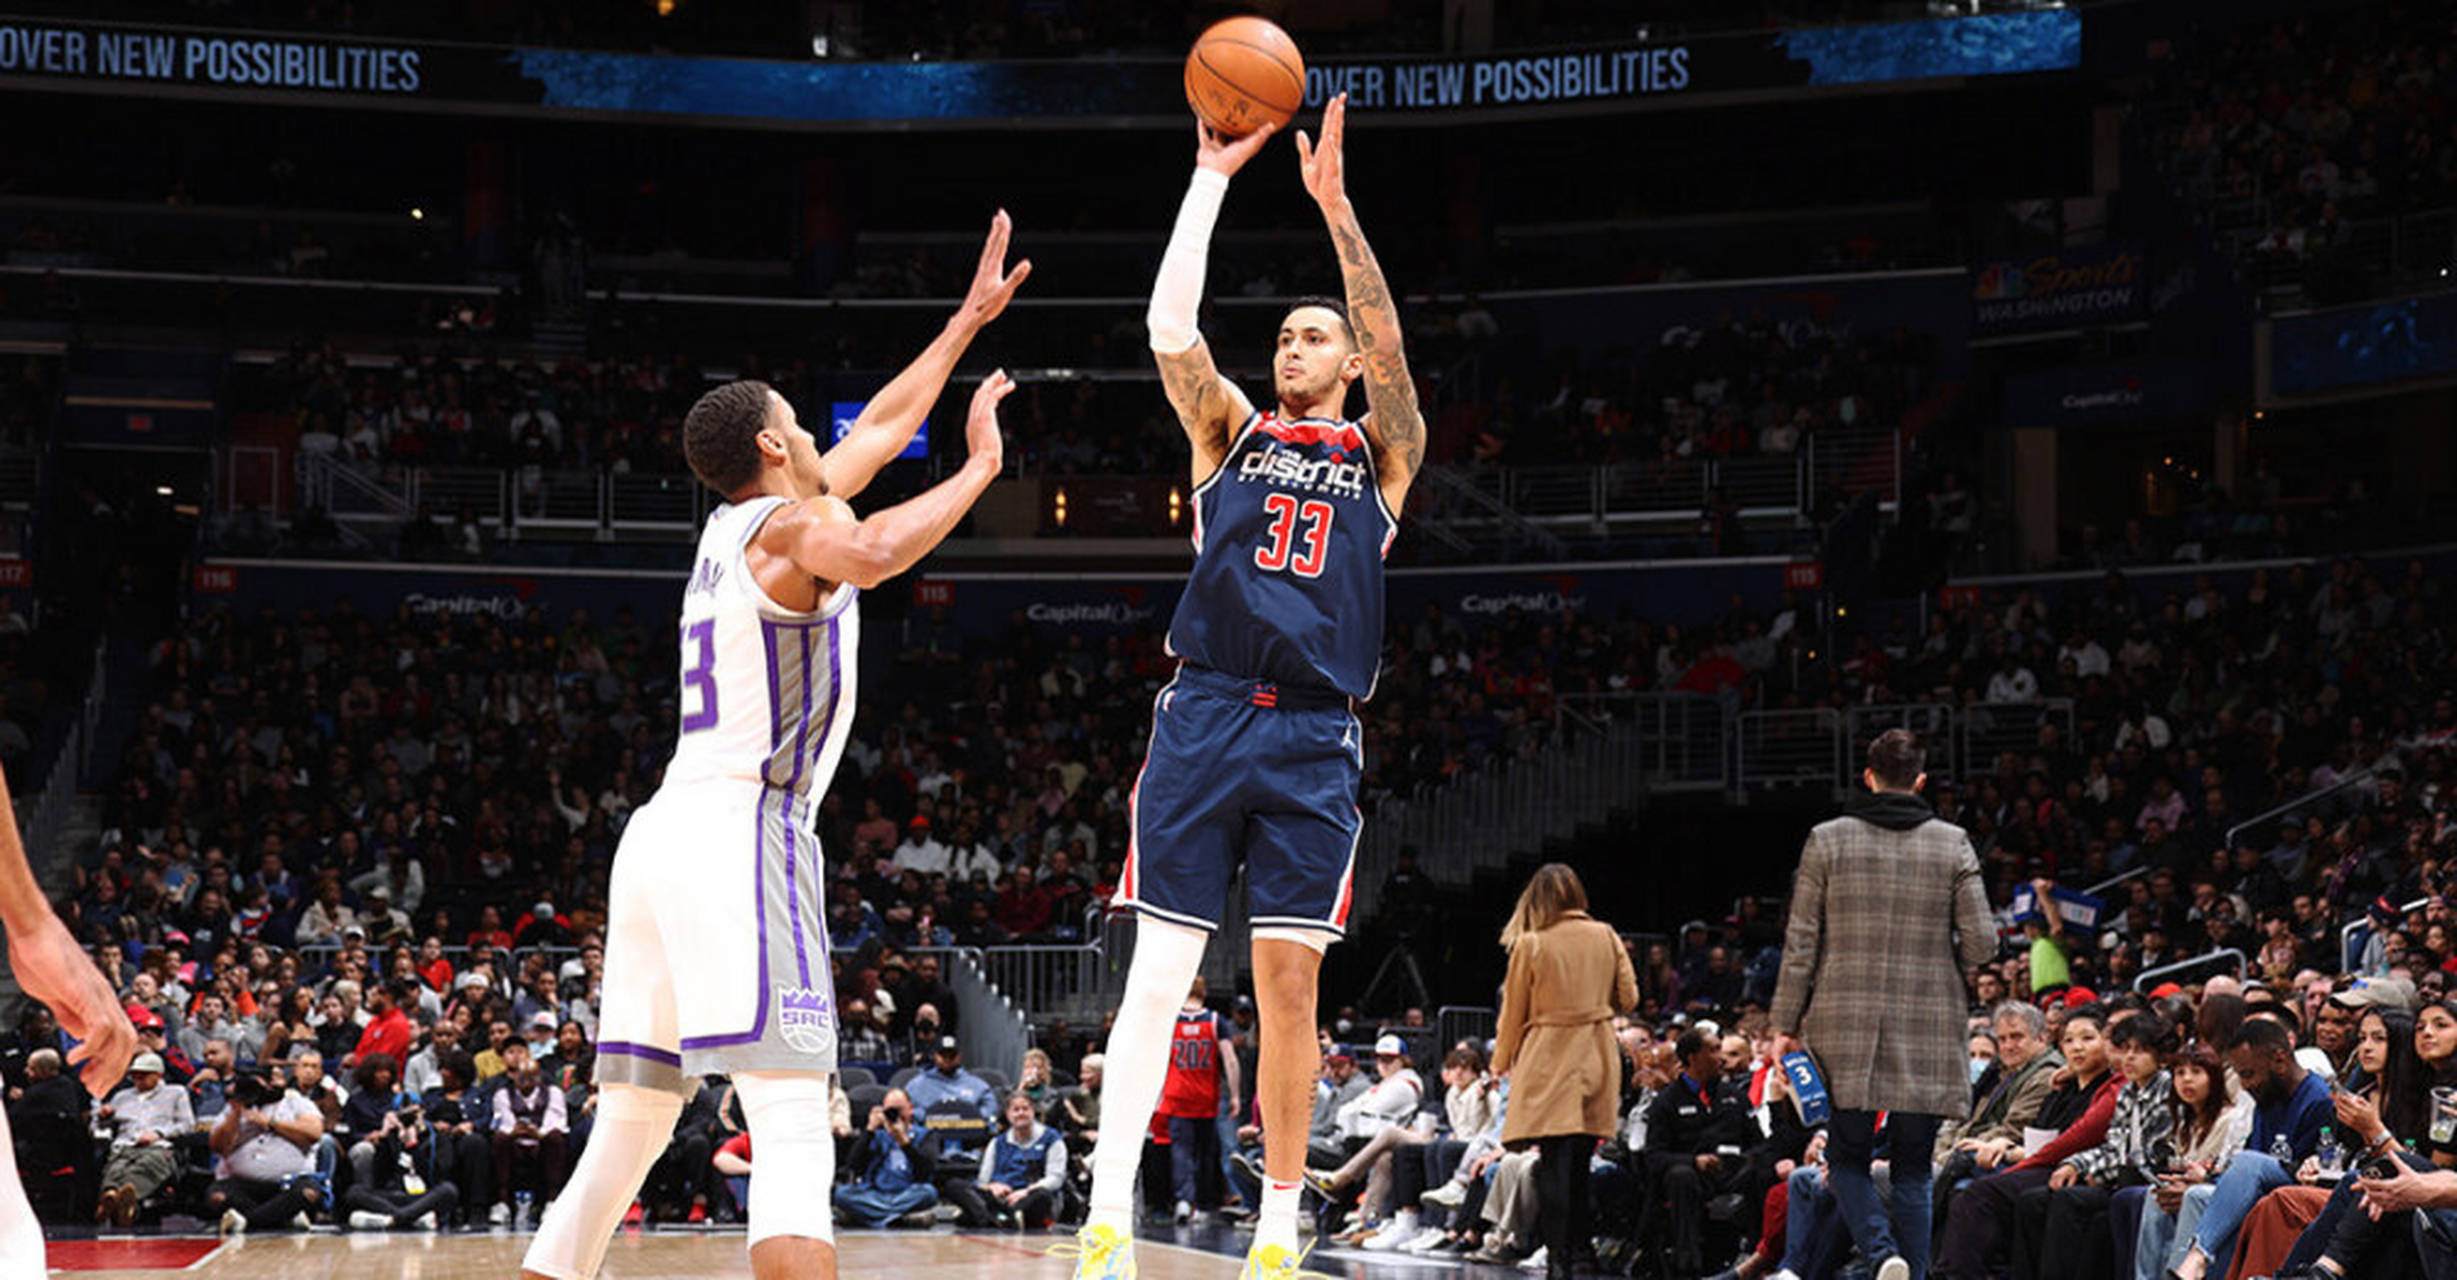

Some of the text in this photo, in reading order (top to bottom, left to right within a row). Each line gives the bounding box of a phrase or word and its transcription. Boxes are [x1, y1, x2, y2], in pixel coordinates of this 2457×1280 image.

[0, 26, 421, 93] OVER NEW POSSIBILITIES
[1304, 46, 1691, 109] OVER NEW POSSIBILITIES
[1977, 287, 2133, 323] WASHINGTON
[1240, 442, 1366, 490] district
[1254, 492, 1335, 578] 33
